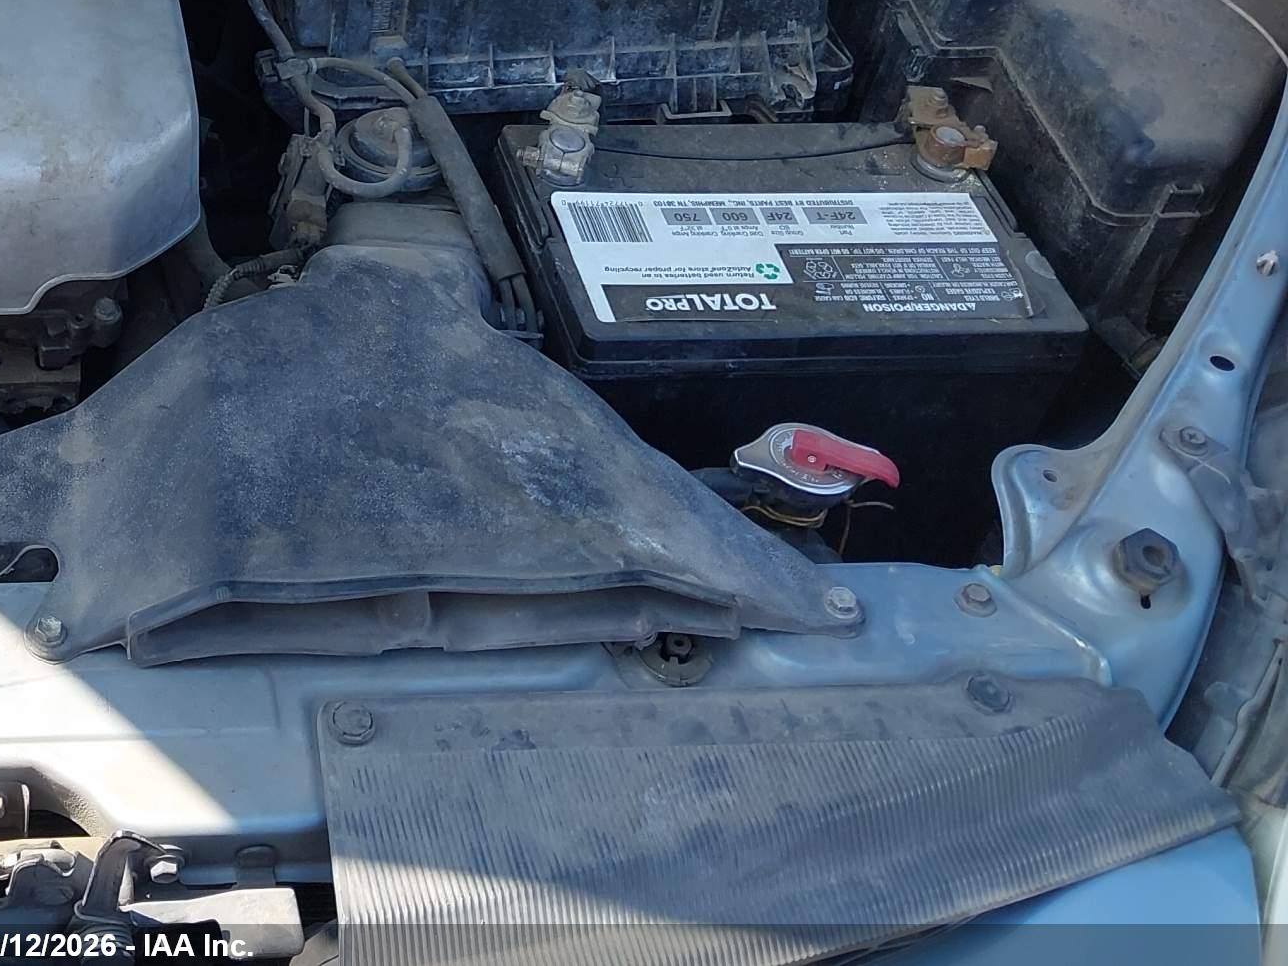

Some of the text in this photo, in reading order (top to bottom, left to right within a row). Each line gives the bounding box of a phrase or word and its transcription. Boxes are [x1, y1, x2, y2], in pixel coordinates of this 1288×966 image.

[674, 212, 699, 222] 750
[722, 212, 748, 221] 600
[767, 212, 791, 220] 24F
[816, 212, 855, 220] 24F-T
[646, 293, 777, 311] TOTALPRO
[863, 302, 968, 312] DANGER/POISON
